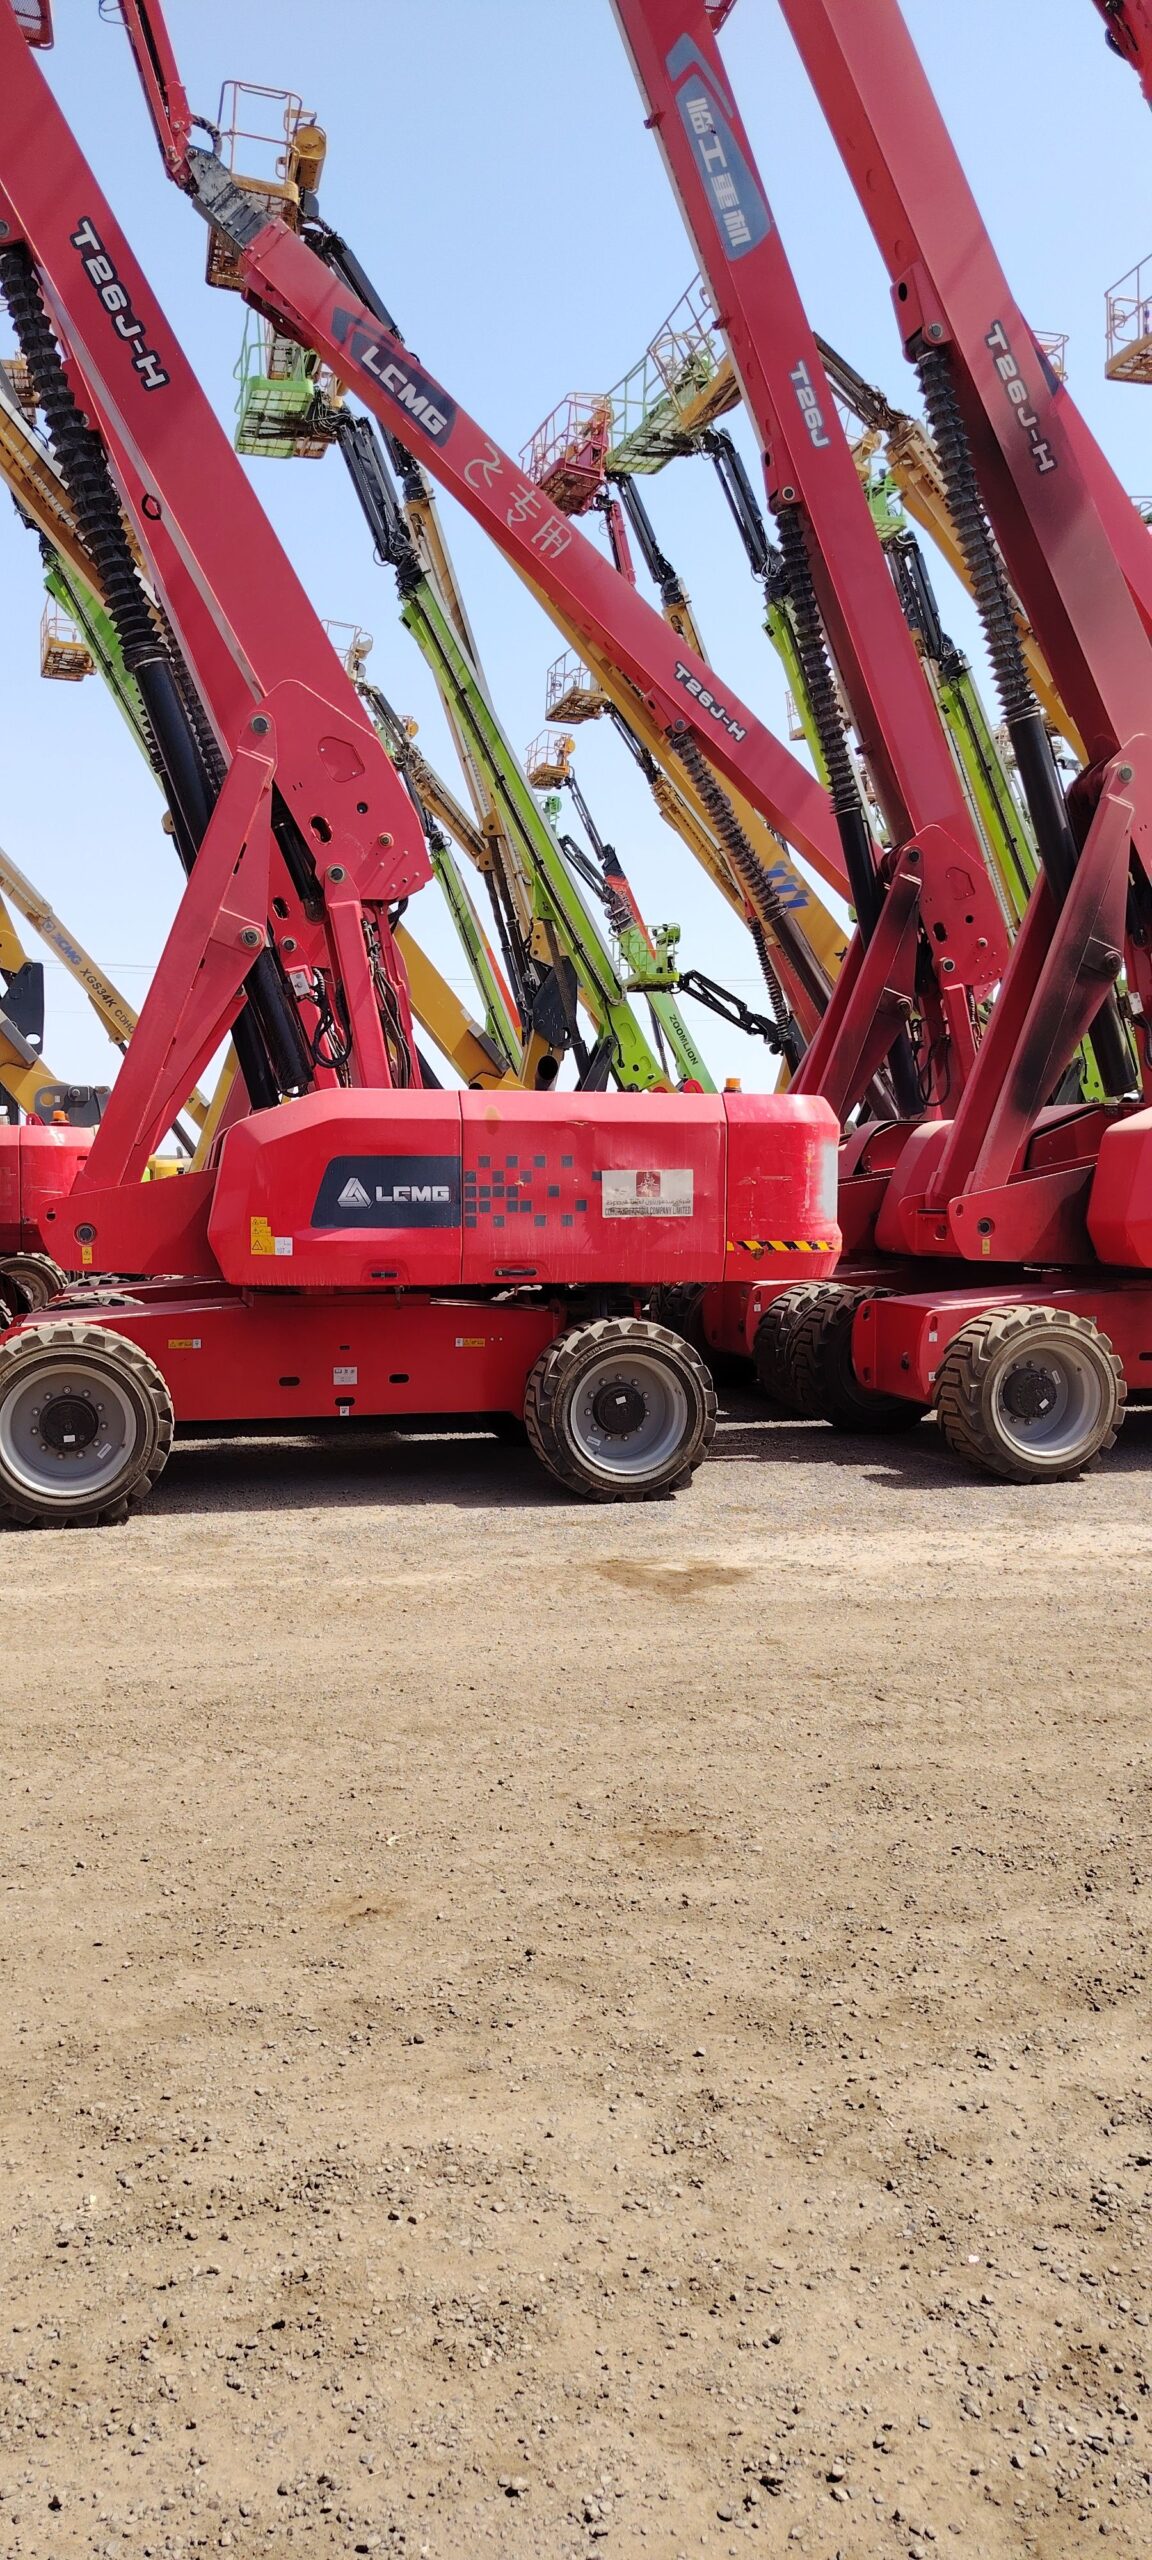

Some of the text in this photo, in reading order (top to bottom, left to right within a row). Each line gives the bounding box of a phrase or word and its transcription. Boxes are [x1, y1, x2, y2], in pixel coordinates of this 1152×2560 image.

[685, 97, 752, 248] 临工重机
[72, 218, 168, 390] T26J-H
[789, 359, 831, 448] T26J
[986, 321, 1056, 474] T26J-H
[674, 661, 747, 742] T26J-H
[52, 931, 82, 966] XCMG
[80, 967, 118, 1008] XGS34K
[669, 1013, 699, 1066] ZOOMLION
